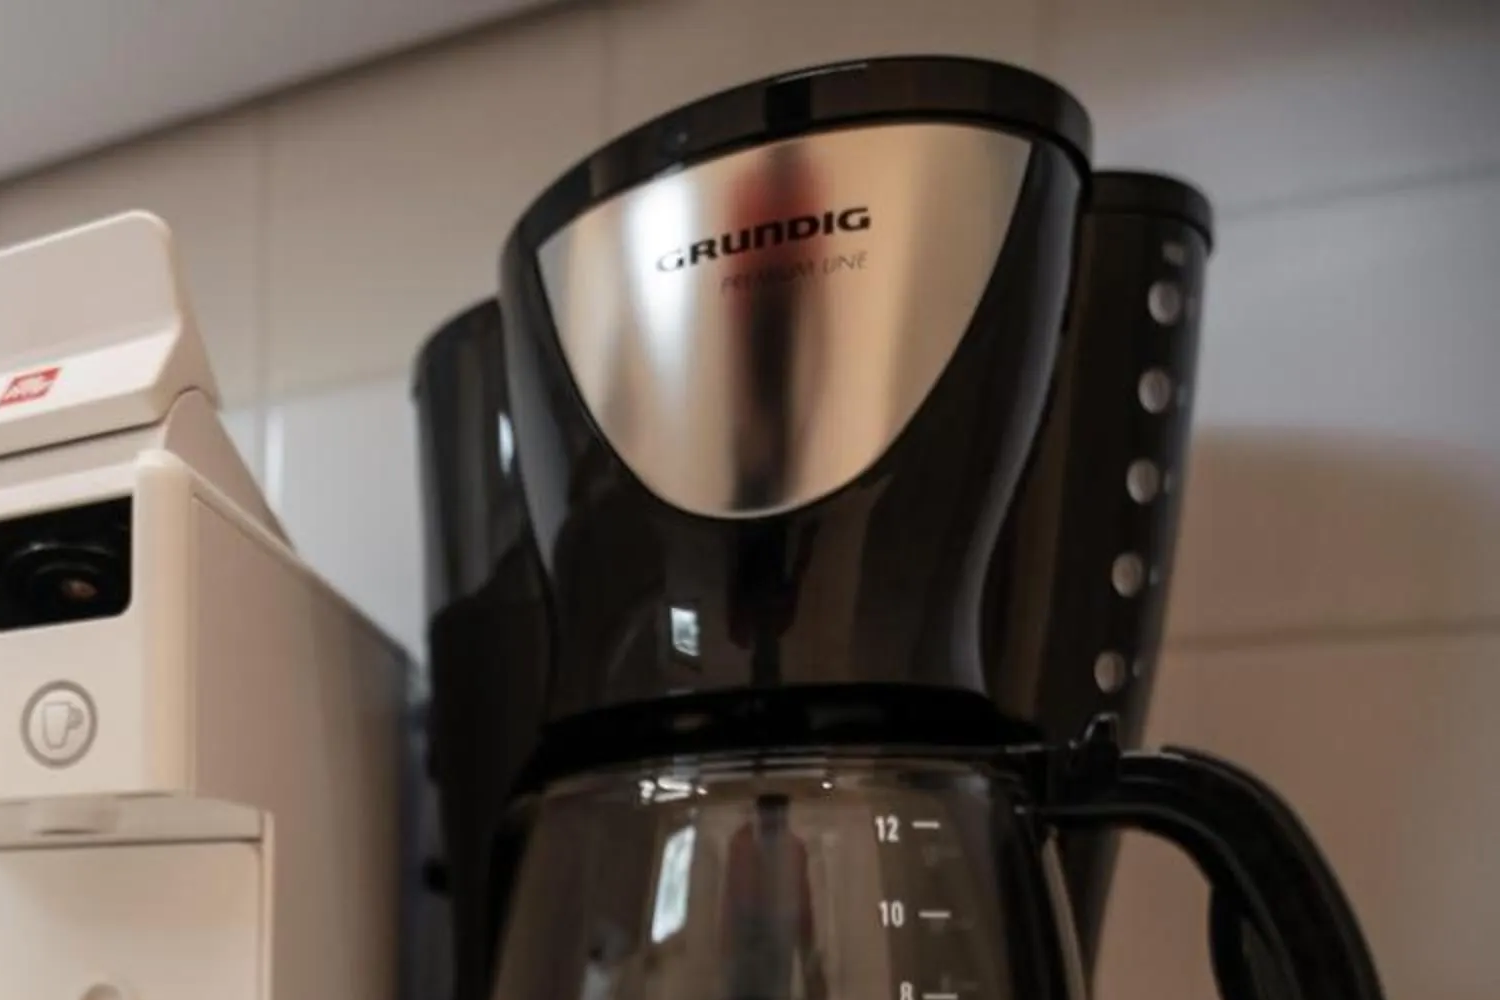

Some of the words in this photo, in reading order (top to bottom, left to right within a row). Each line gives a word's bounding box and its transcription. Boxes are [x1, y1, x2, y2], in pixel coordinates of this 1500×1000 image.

[656, 206, 872, 272] GRUNDIG
[721, 259, 814, 293] PREUM
[822, 251, 869, 275] LINE
[875, 815, 899, 842] 12
[880, 900, 904, 927] 10
